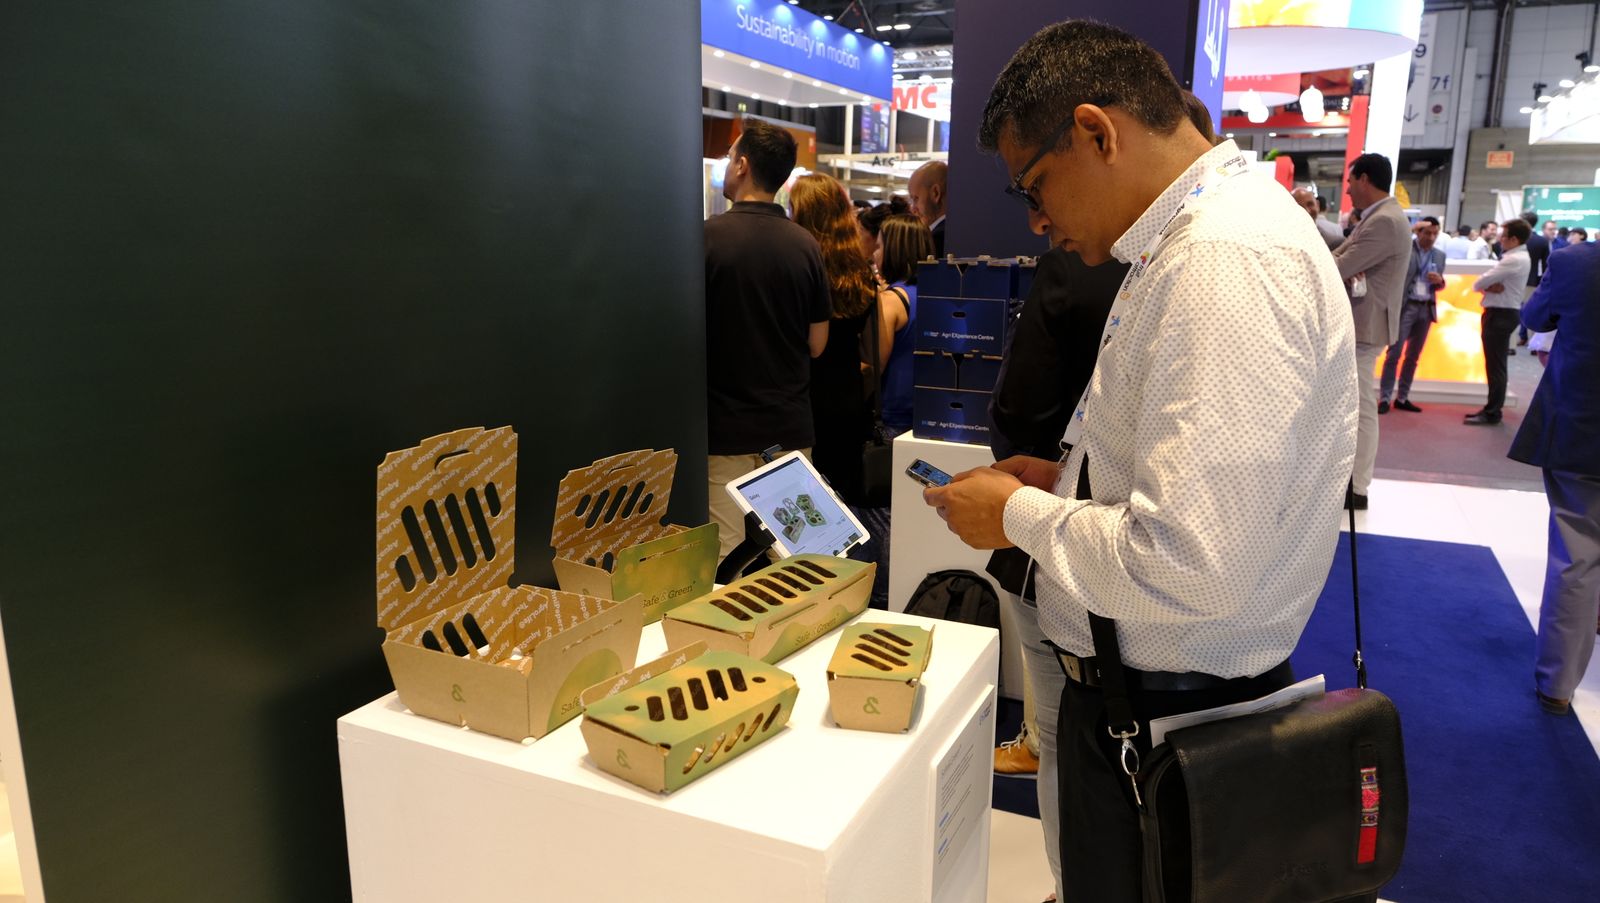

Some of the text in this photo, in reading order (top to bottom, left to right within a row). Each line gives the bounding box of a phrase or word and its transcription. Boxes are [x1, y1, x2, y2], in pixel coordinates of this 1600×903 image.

[736, 4, 860, 70] Sustainability in motion
[1414, 44, 1427, 58] 9
[1431, 74, 1451, 90] 7f
[1123, 261, 1139, 291] attraction
[942, 331, 952, 342] Agri
[977, 334, 995, 342] Centre
[940, 421, 950, 431] Agri
[667, 585, 693, 600] Green
[451, 684, 466, 704] &
[862, 696, 881, 715] &
[617, 749, 632, 769] &
